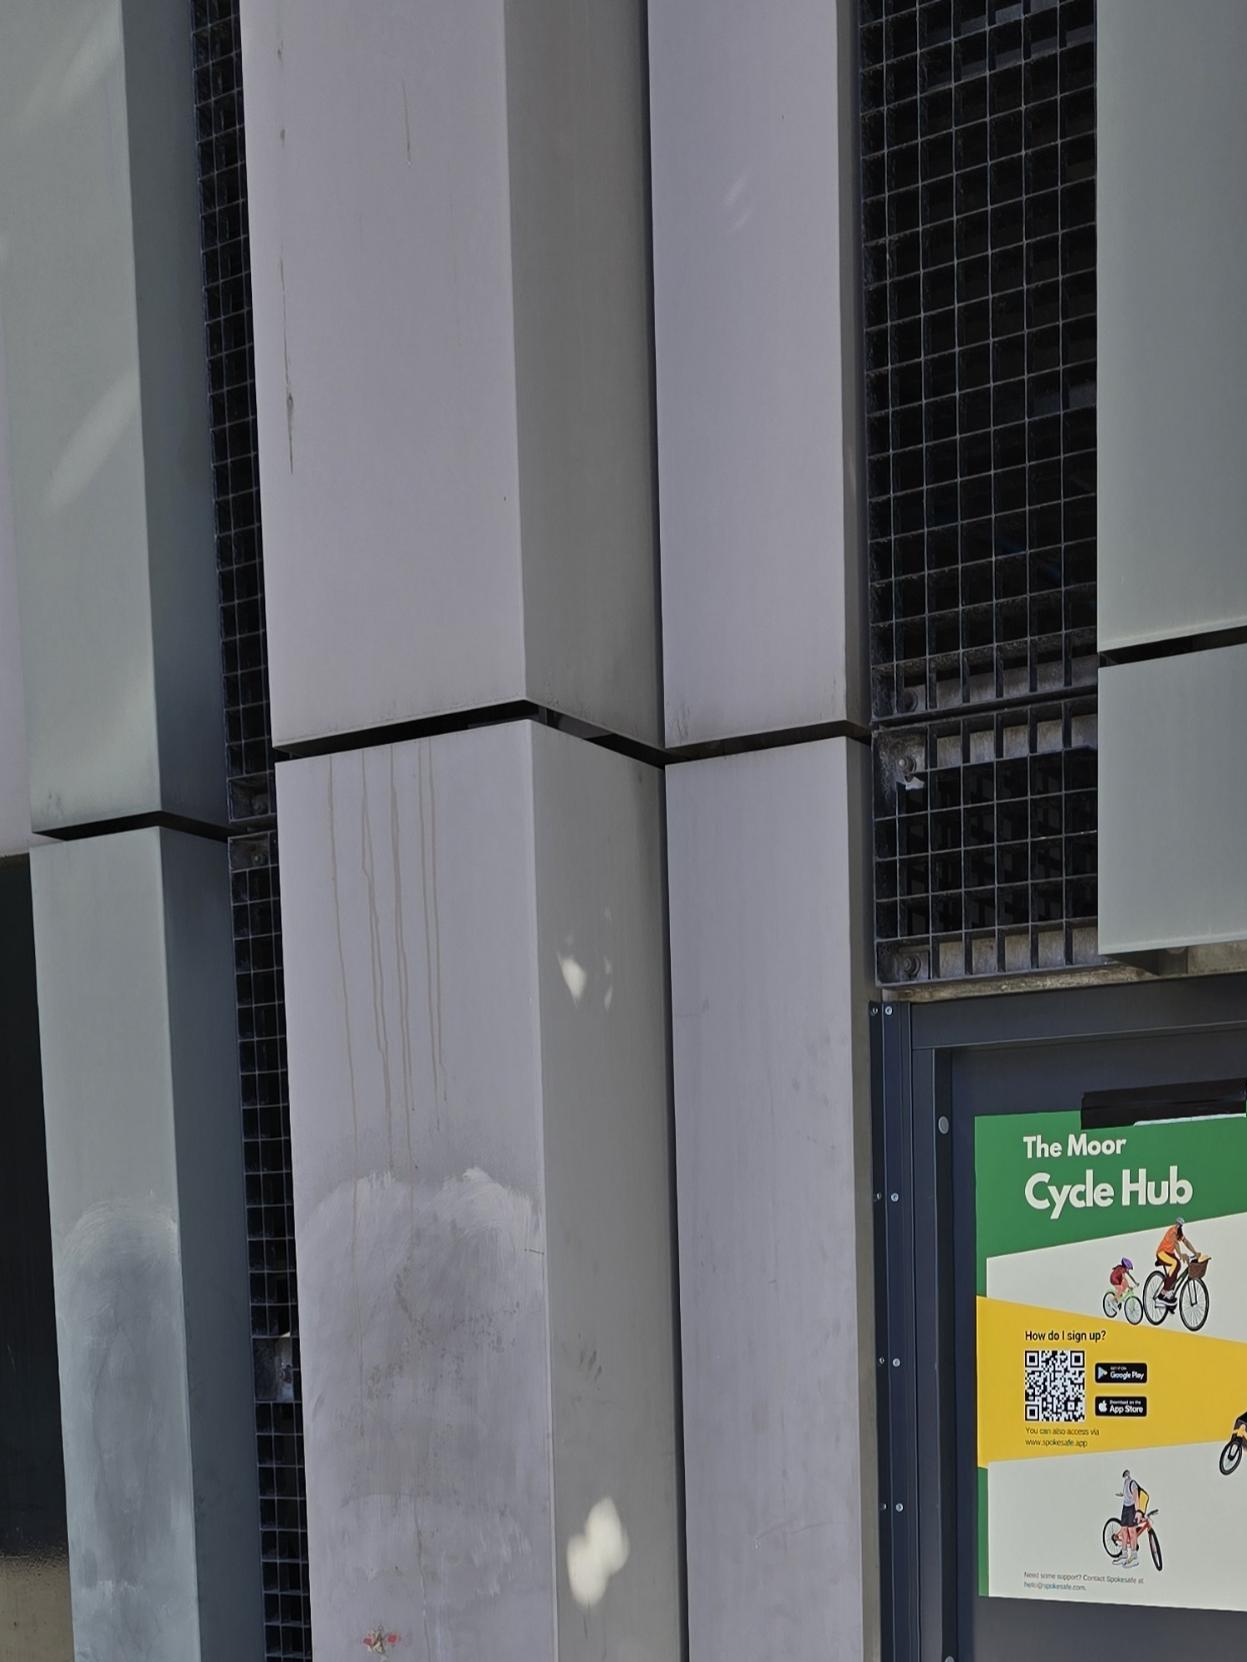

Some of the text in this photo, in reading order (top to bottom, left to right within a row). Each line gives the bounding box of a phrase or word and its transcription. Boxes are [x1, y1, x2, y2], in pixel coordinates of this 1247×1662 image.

[1023, 1133, 1127, 1159] The Moor
[1024, 1165, 1194, 1220] Cycle Hub
[1025, 1330, 1107, 1343] How do I sign up?
[1110, 1371, 1145, 1381] Google Play
[1109, 1405, 1144, 1414] App Store
[1025, 1426, 1039, 1434] You
[1090, 1428, 1100, 1436] via
[1056, 1573, 1082, 1581] support?
[1082, 1574, 1105, 1582] Contact
[1106, 1575, 1137, 1584] Spokesafe
